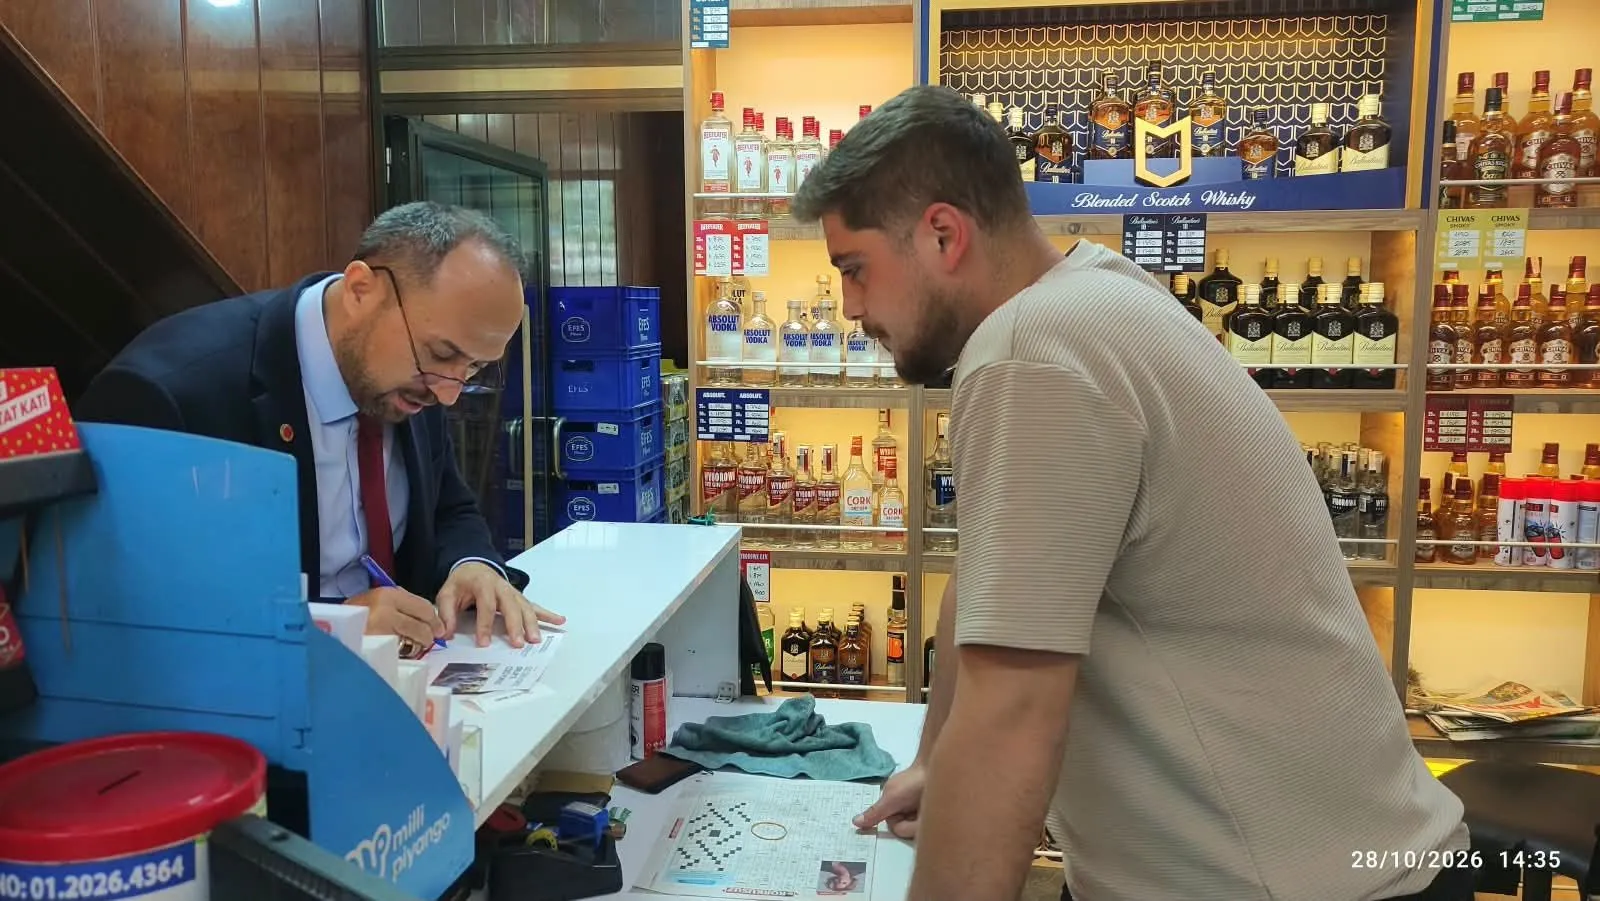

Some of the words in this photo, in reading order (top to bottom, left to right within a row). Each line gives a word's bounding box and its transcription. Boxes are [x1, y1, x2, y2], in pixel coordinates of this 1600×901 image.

[1071, 192, 1138, 208] Blended
[1142, 191, 1192, 207] Scotch
[1200, 190, 1256, 209] Whisky
[638, 317, 649, 331] EFES
[708, 315, 739, 323] ABSOLUT
[711, 323, 737, 331] VODKA
[640, 430, 653, 444] EFES
[847, 496, 871, 506] CORK
[393, 803, 424, 852] milli
[392, 812, 450, 883] piyango
[30, 855, 185, 900] 01.2026.4364
